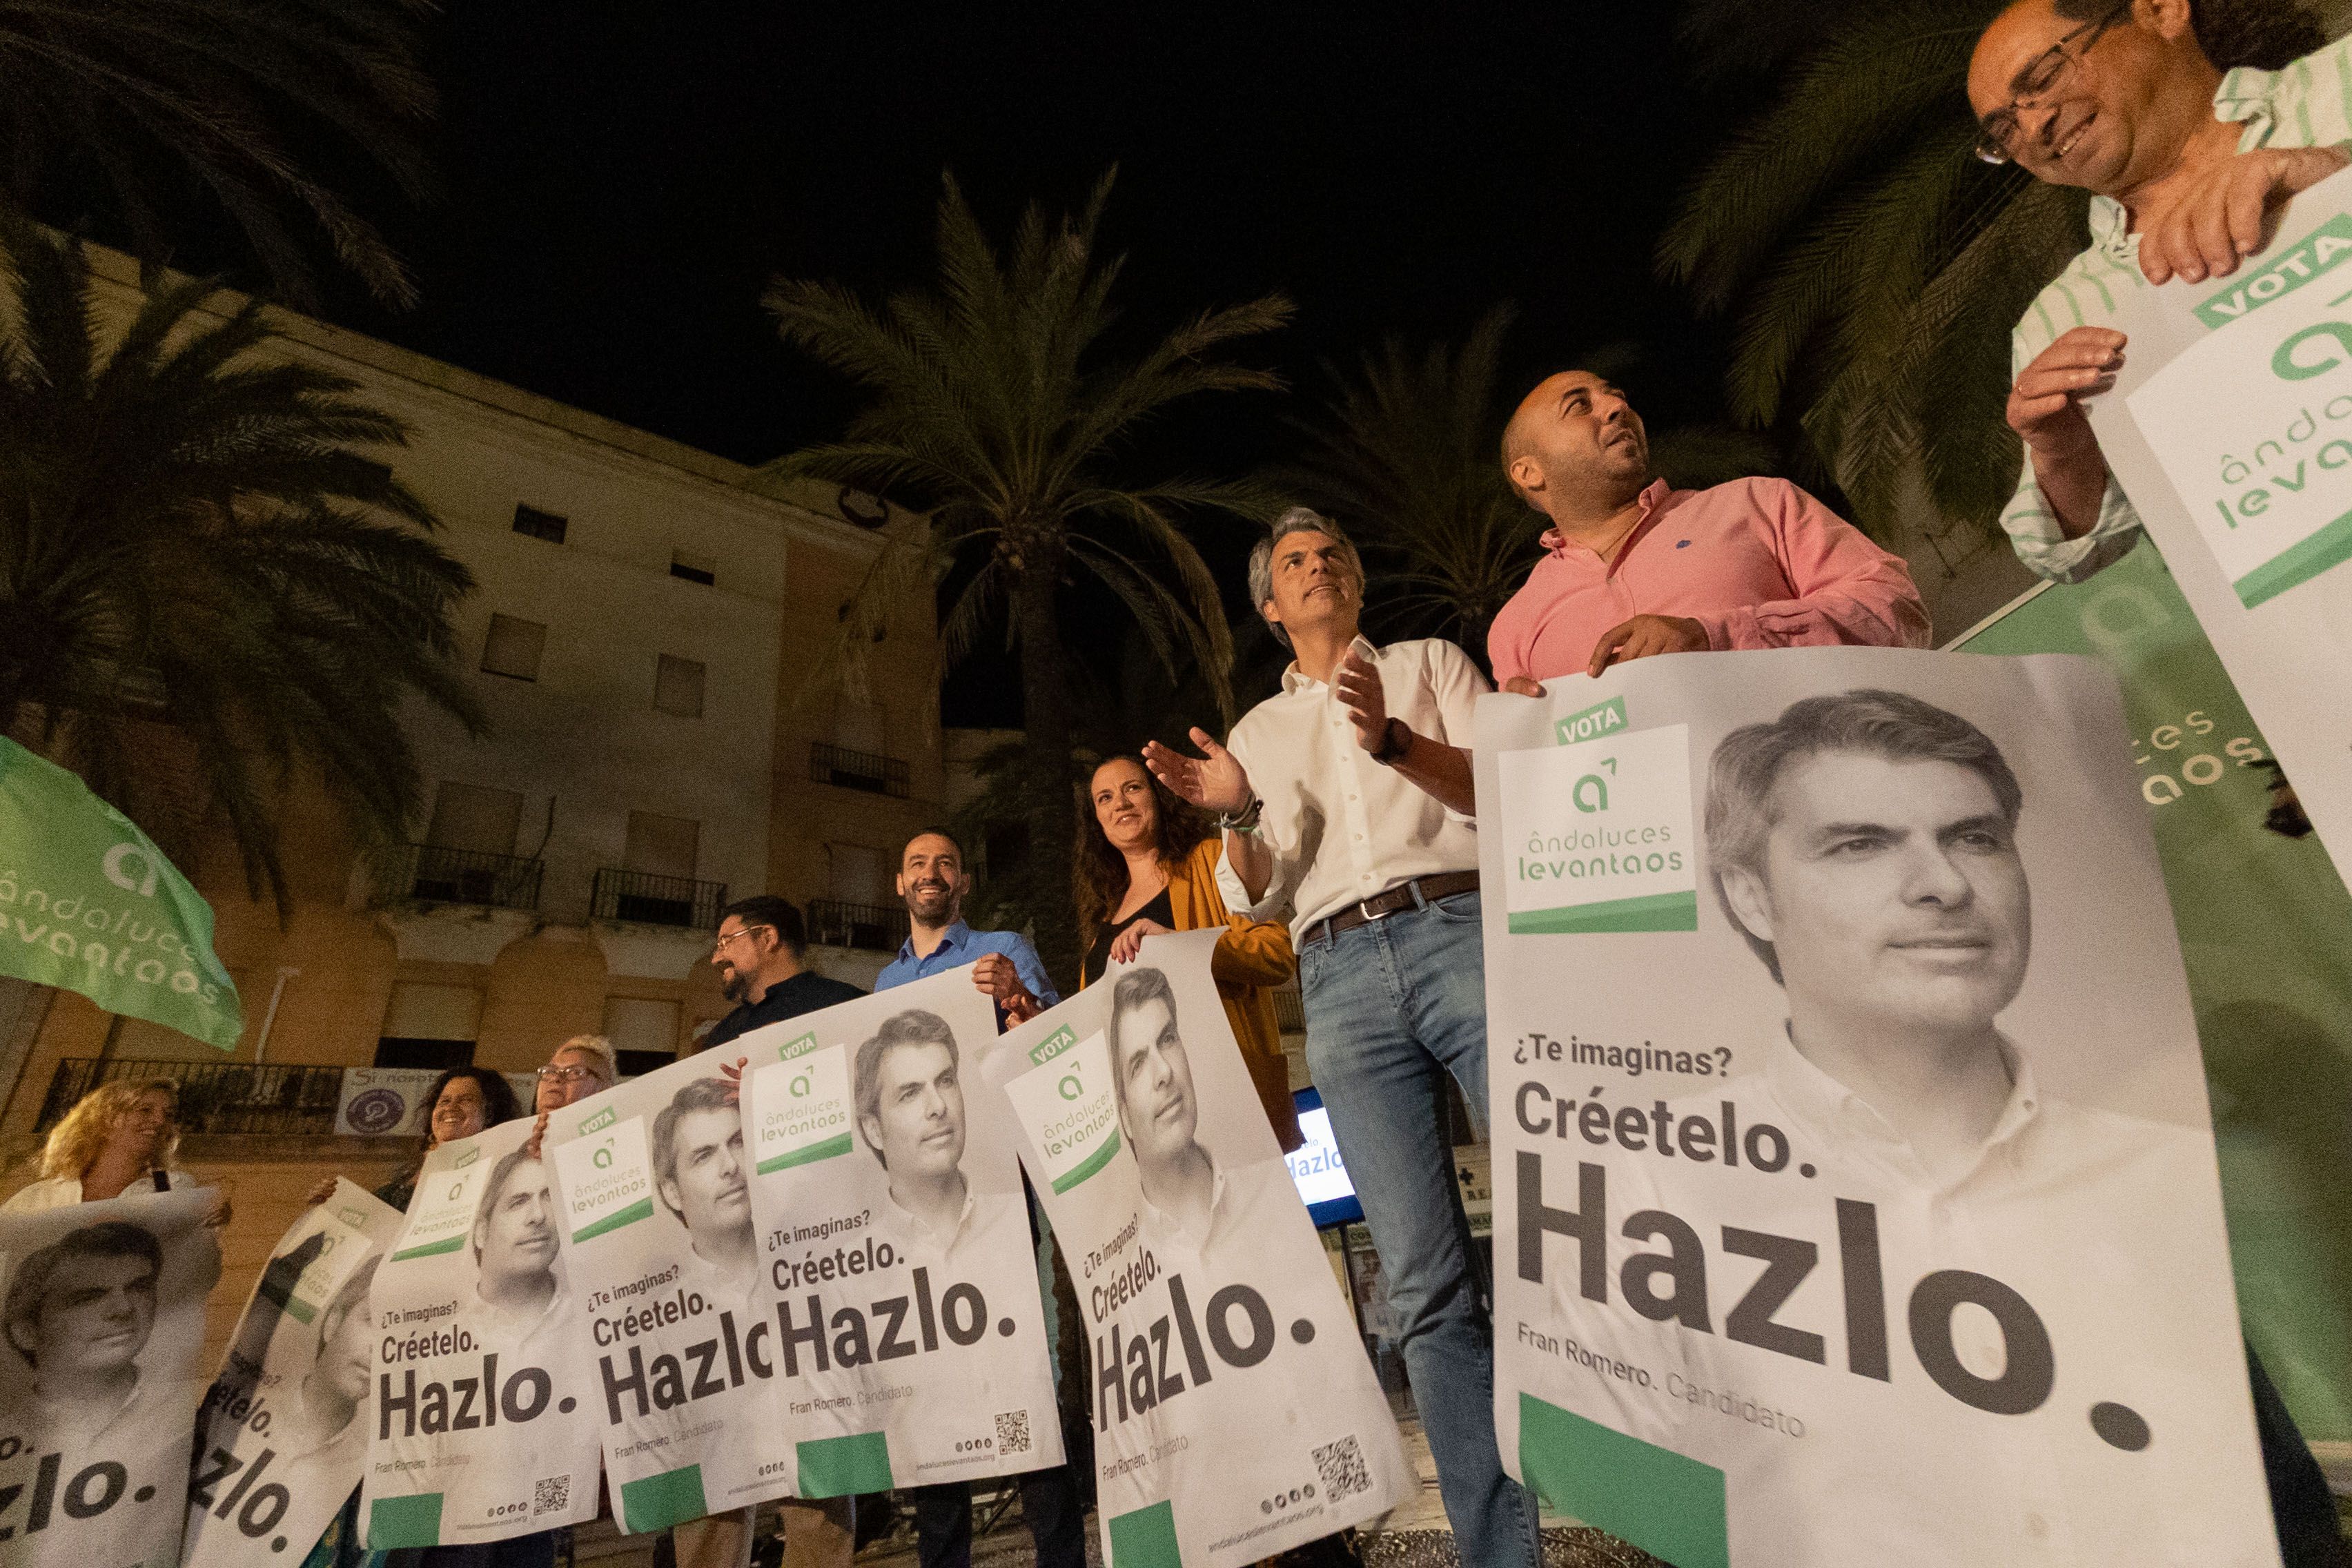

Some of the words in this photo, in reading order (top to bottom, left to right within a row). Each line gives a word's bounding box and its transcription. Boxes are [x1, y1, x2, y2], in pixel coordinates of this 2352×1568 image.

[2211, 235, 2352, 316] VOTA
[1560, 706, 1623, 744] VOTA
[1527, 824, 1672, 855] ândaluces
[1518, 849, 1684, 882] levantaos
[783, 1037, 814, 1059] VOTA
[1035, 1031, 1073, 1063] VOTA
[1513, 1033, 1562, 1066] ¿Te
[1571, 1035, 1732, 1078] imaginas?
[582, 1112, 613, 1134] VOTA
[761, 1112, 846, 1142] levantaos
[766, 1099, 840, 1126] ândaluces
[1043, 1104, 1115, 1159] levantaos
[1044, 1090, 1110, 1139] ândaluces
[1515, 1080, 1818, 1179] Créetelo.
[572, 1178, 646, 1213] levantaos
[768, 1231, 790, 1252] ¿Te
[793, 1209, 870, 1242] imaginas?
[1084, 1251, 1102, 1279] ¿Te
[1102, 1213, 1139, 1262] imaginas?
[772, 1237, 904, 1291] Créetelo.
[1092, 1244, 1161, 1324] Créetelo.
[588, 1292, 610, 1313] ¿Te
[613, 1264, 679, 1300] imaginas?
[1516, 1148, 2152, 1453] Hazlo.
[381, 1311, 400, 1329] ¿Te
[403, 1300, 458, 1323] imaginas?
[594, 1289, 713, 1346] Créetelo.
[777, 1266, 1017, 1377] Hazlo.
[382, 1324, 480, 1364] Créetelo.
[1095, 1273, 1317, 1433] Hazlo.
[380, 1352, 577, 1440] Hazlo.
[790, 1402, 812, 1415] Fran
[814, 1396, 855, 1411] Romero.
[857, 1385, 913, 1406] Candidato
[1518, 1321, 1559, 1358] Fran
[1565, 1338, 1658, 1390] Romero.
[1665, 1371, 1805, 1439] Candidato
[615, 1444, 635, 1459] Fran
[1102, 1465, 1117, 1481] Fran
[1118, 1453, 1148, 1476] Romero.
